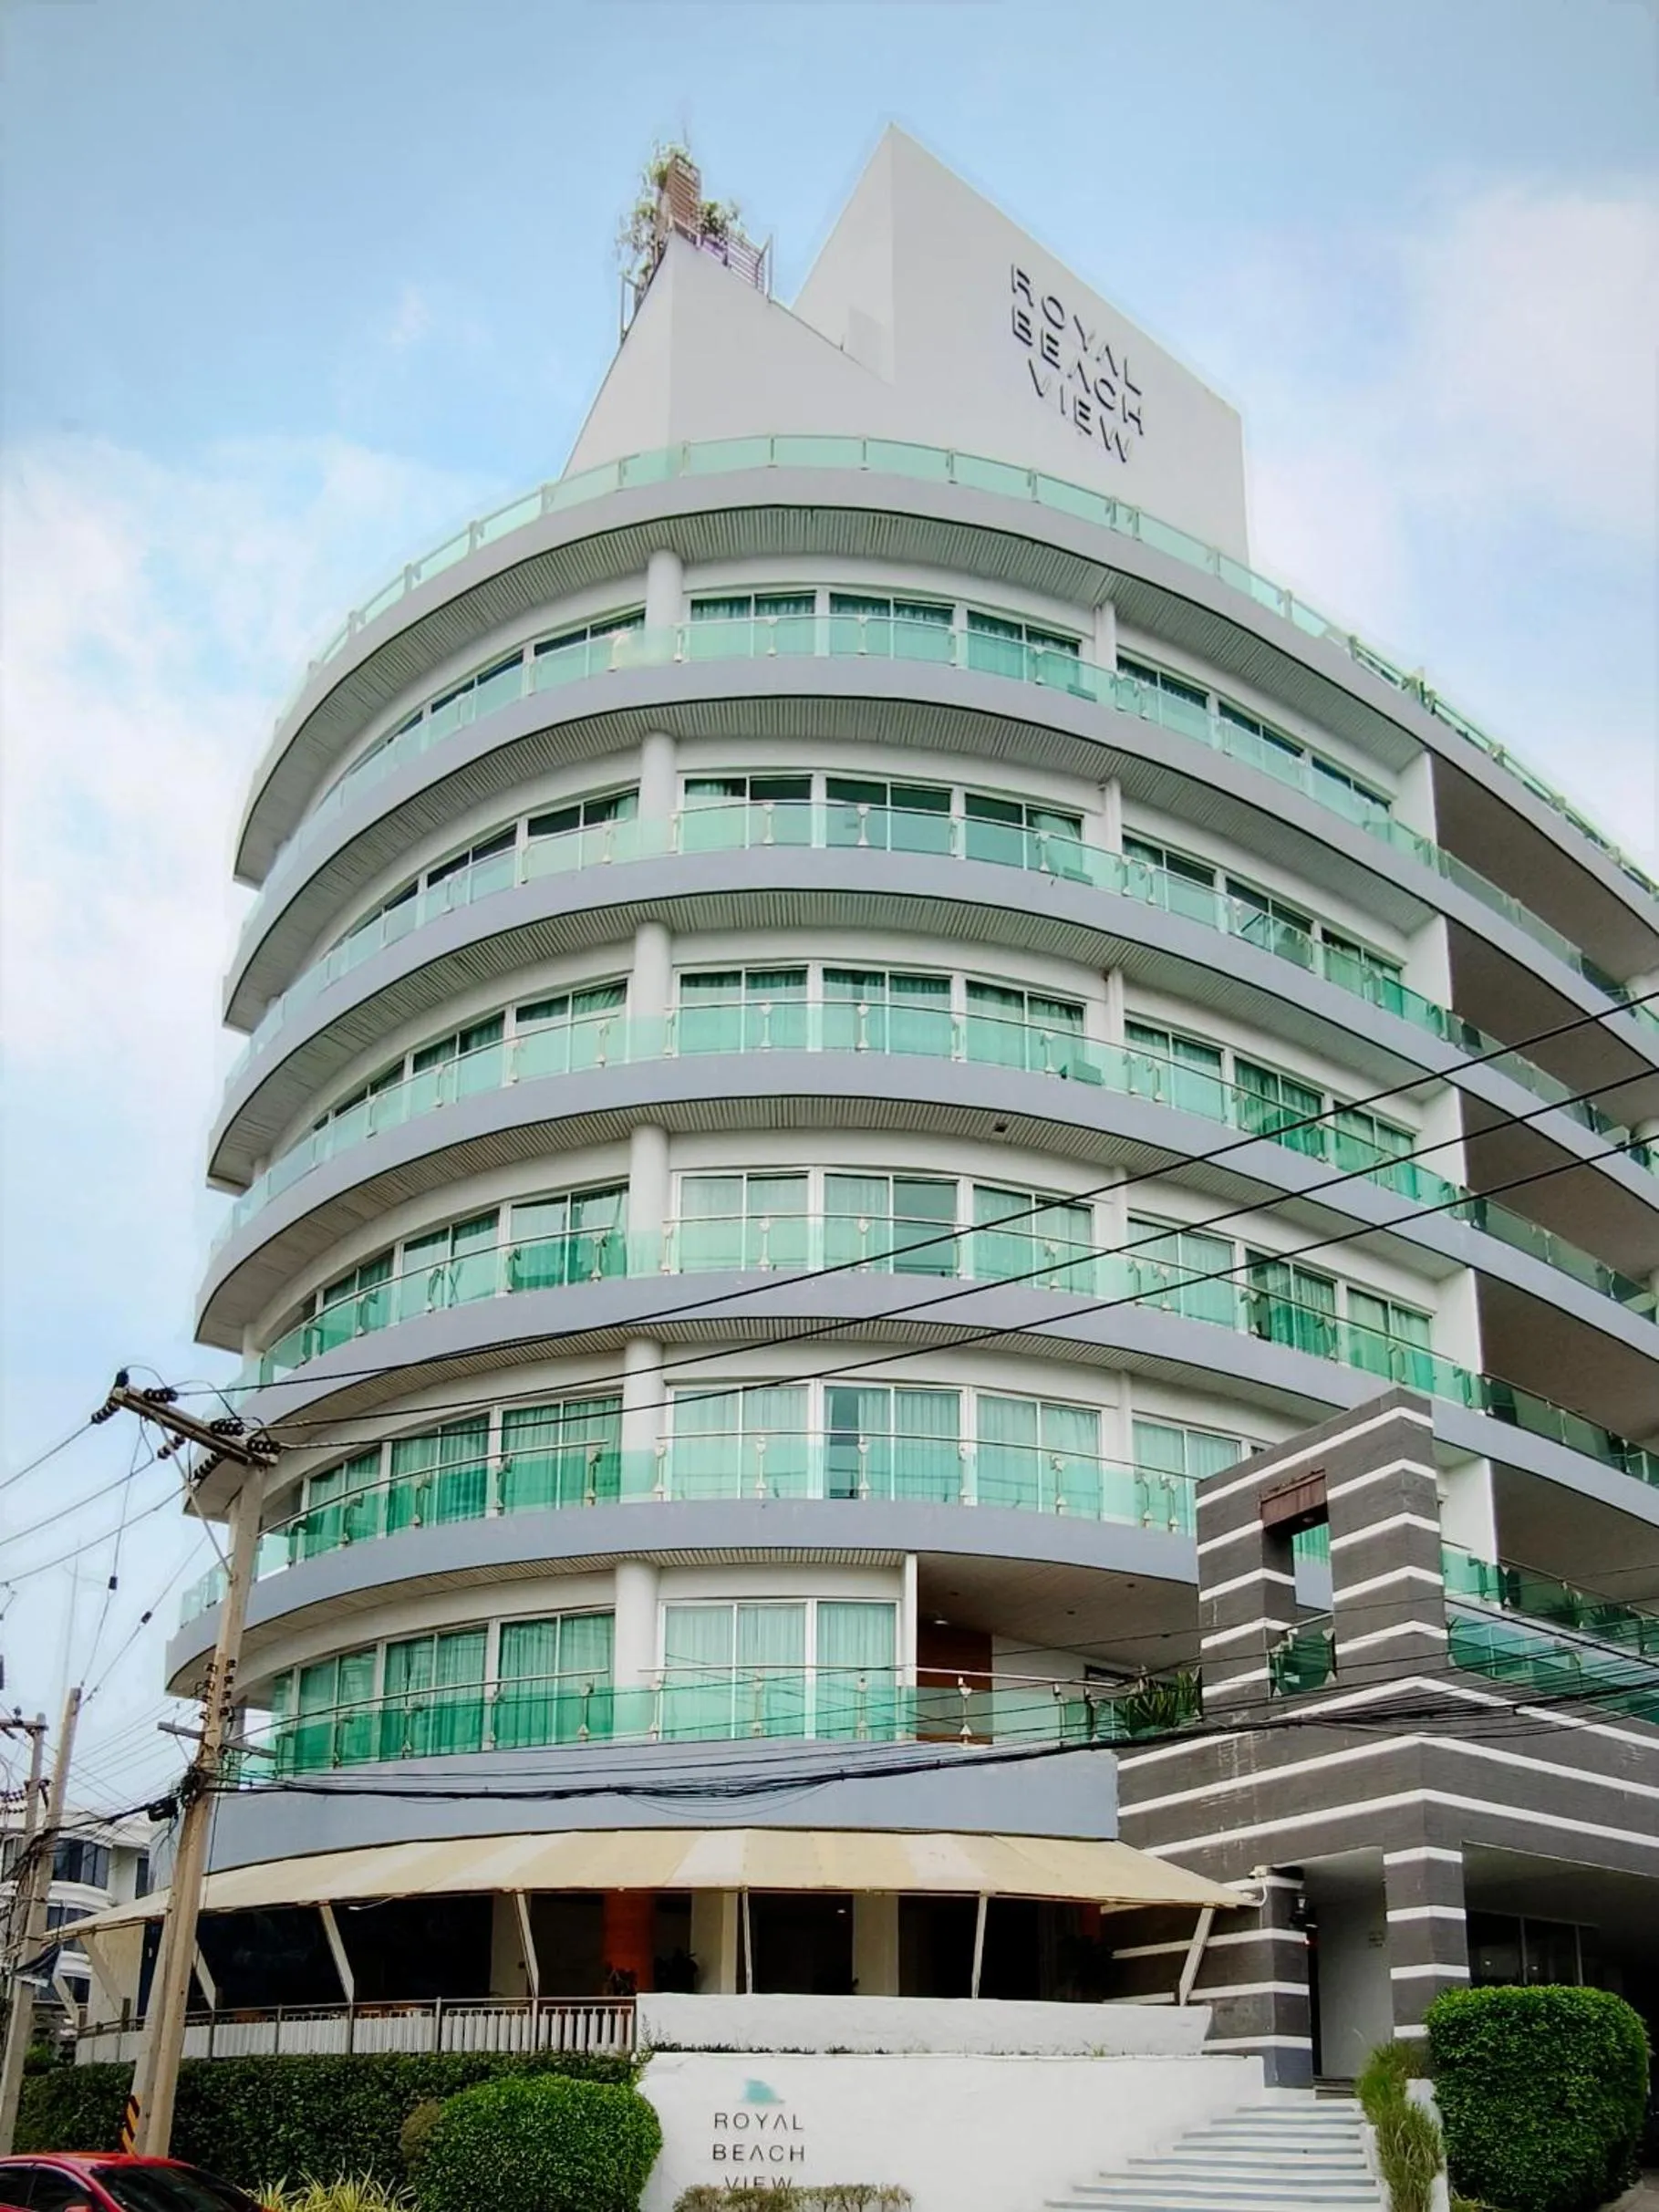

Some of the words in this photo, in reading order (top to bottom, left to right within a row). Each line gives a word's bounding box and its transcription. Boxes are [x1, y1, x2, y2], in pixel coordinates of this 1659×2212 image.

[1011, 264, 1142, 396] ROYAL
[1012, 305, 1144, 436] BEACH
[1028, 358, 1130, 463] VIEW
[714, 2112, 804, 2131] ROYAL
[712, 2144, 804, 2162] BEACH
[724, 2175, 793, 2190] VIEW
